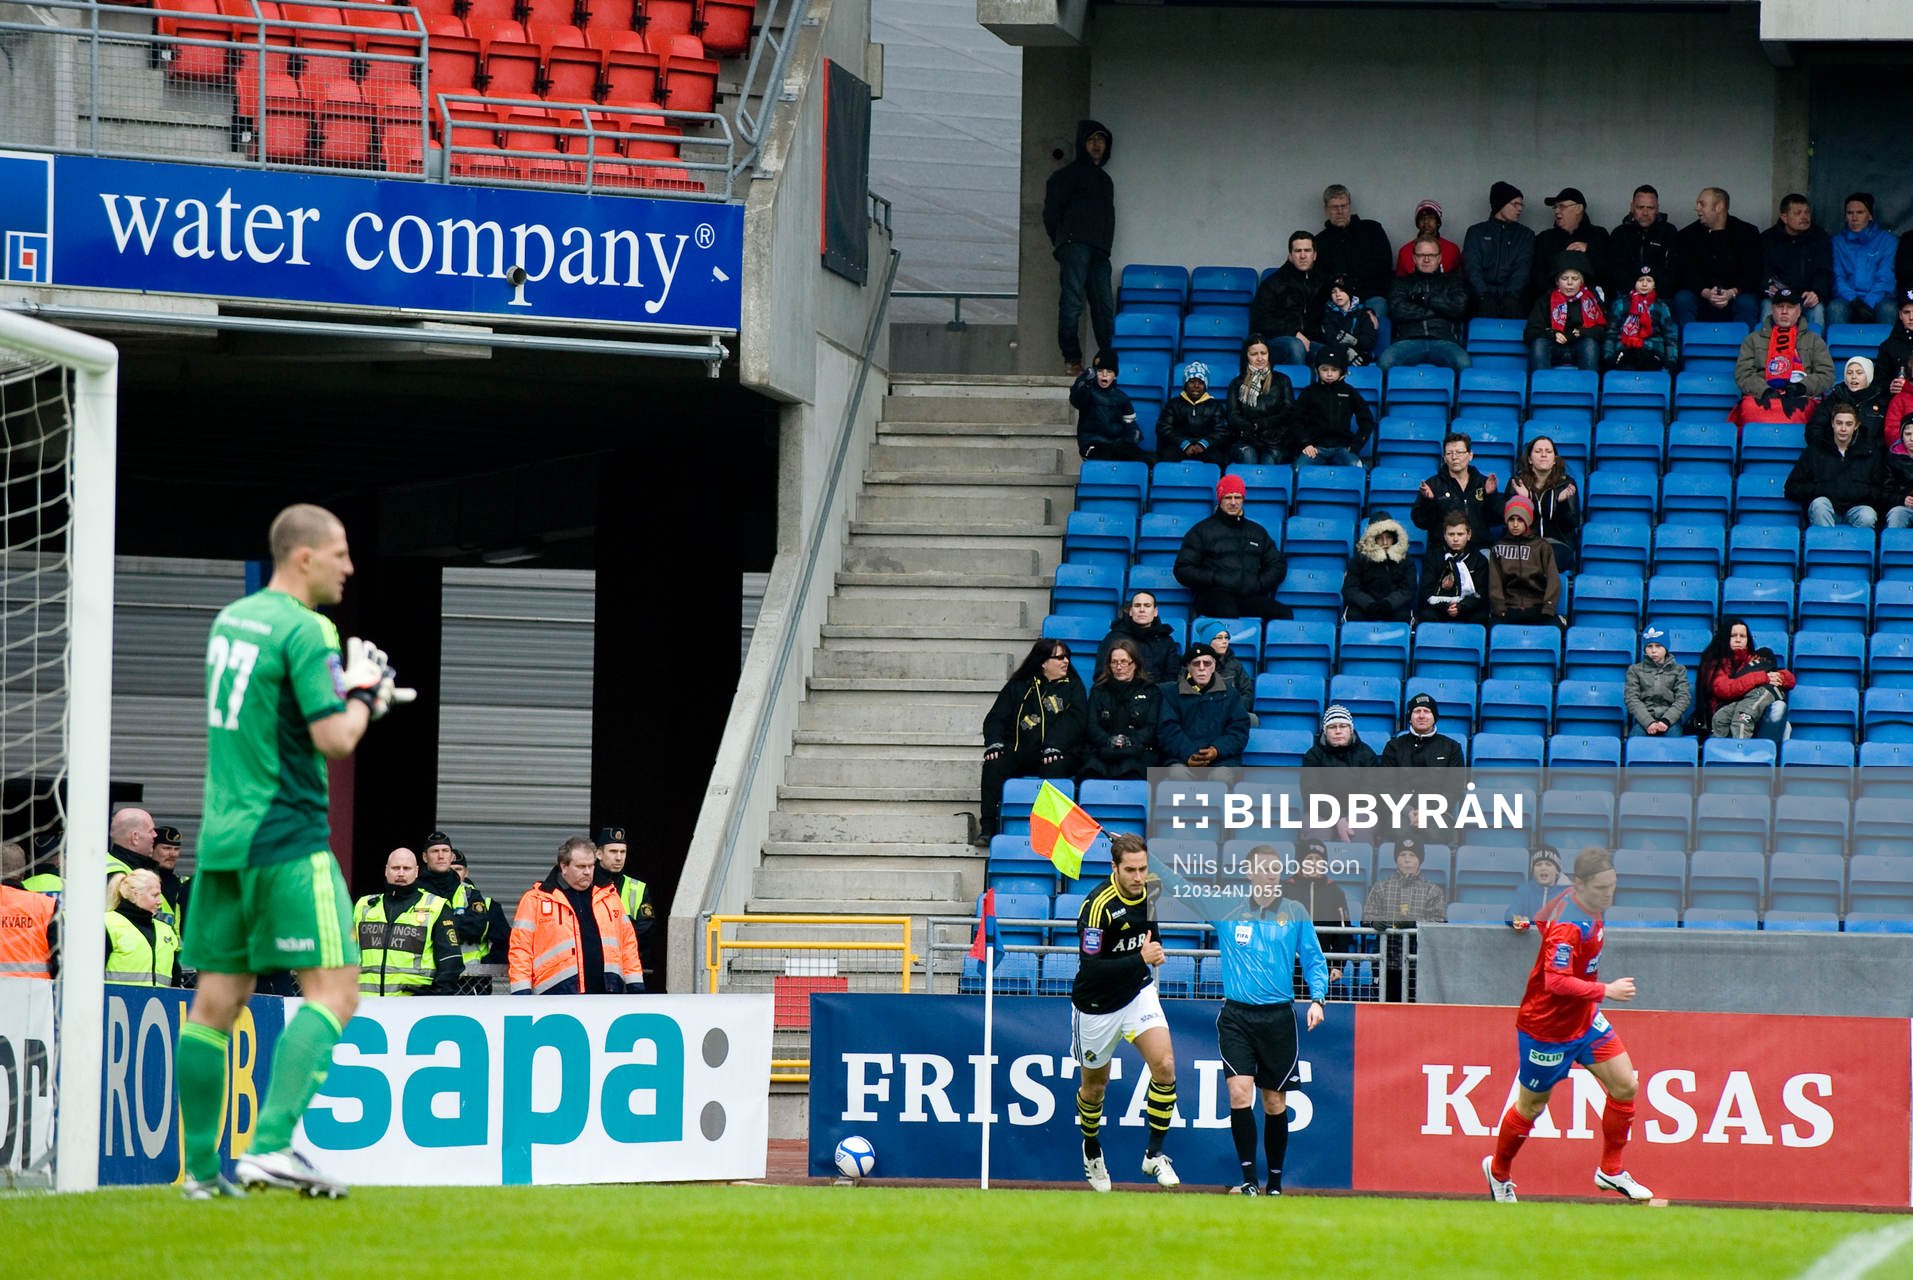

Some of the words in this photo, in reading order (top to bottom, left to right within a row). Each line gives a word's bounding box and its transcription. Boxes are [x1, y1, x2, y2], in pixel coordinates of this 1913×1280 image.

[100, 188, 320, 265] water
[207, 635, 260, 731] 27
[1531, 1051, 1563, 1062] SOLID
